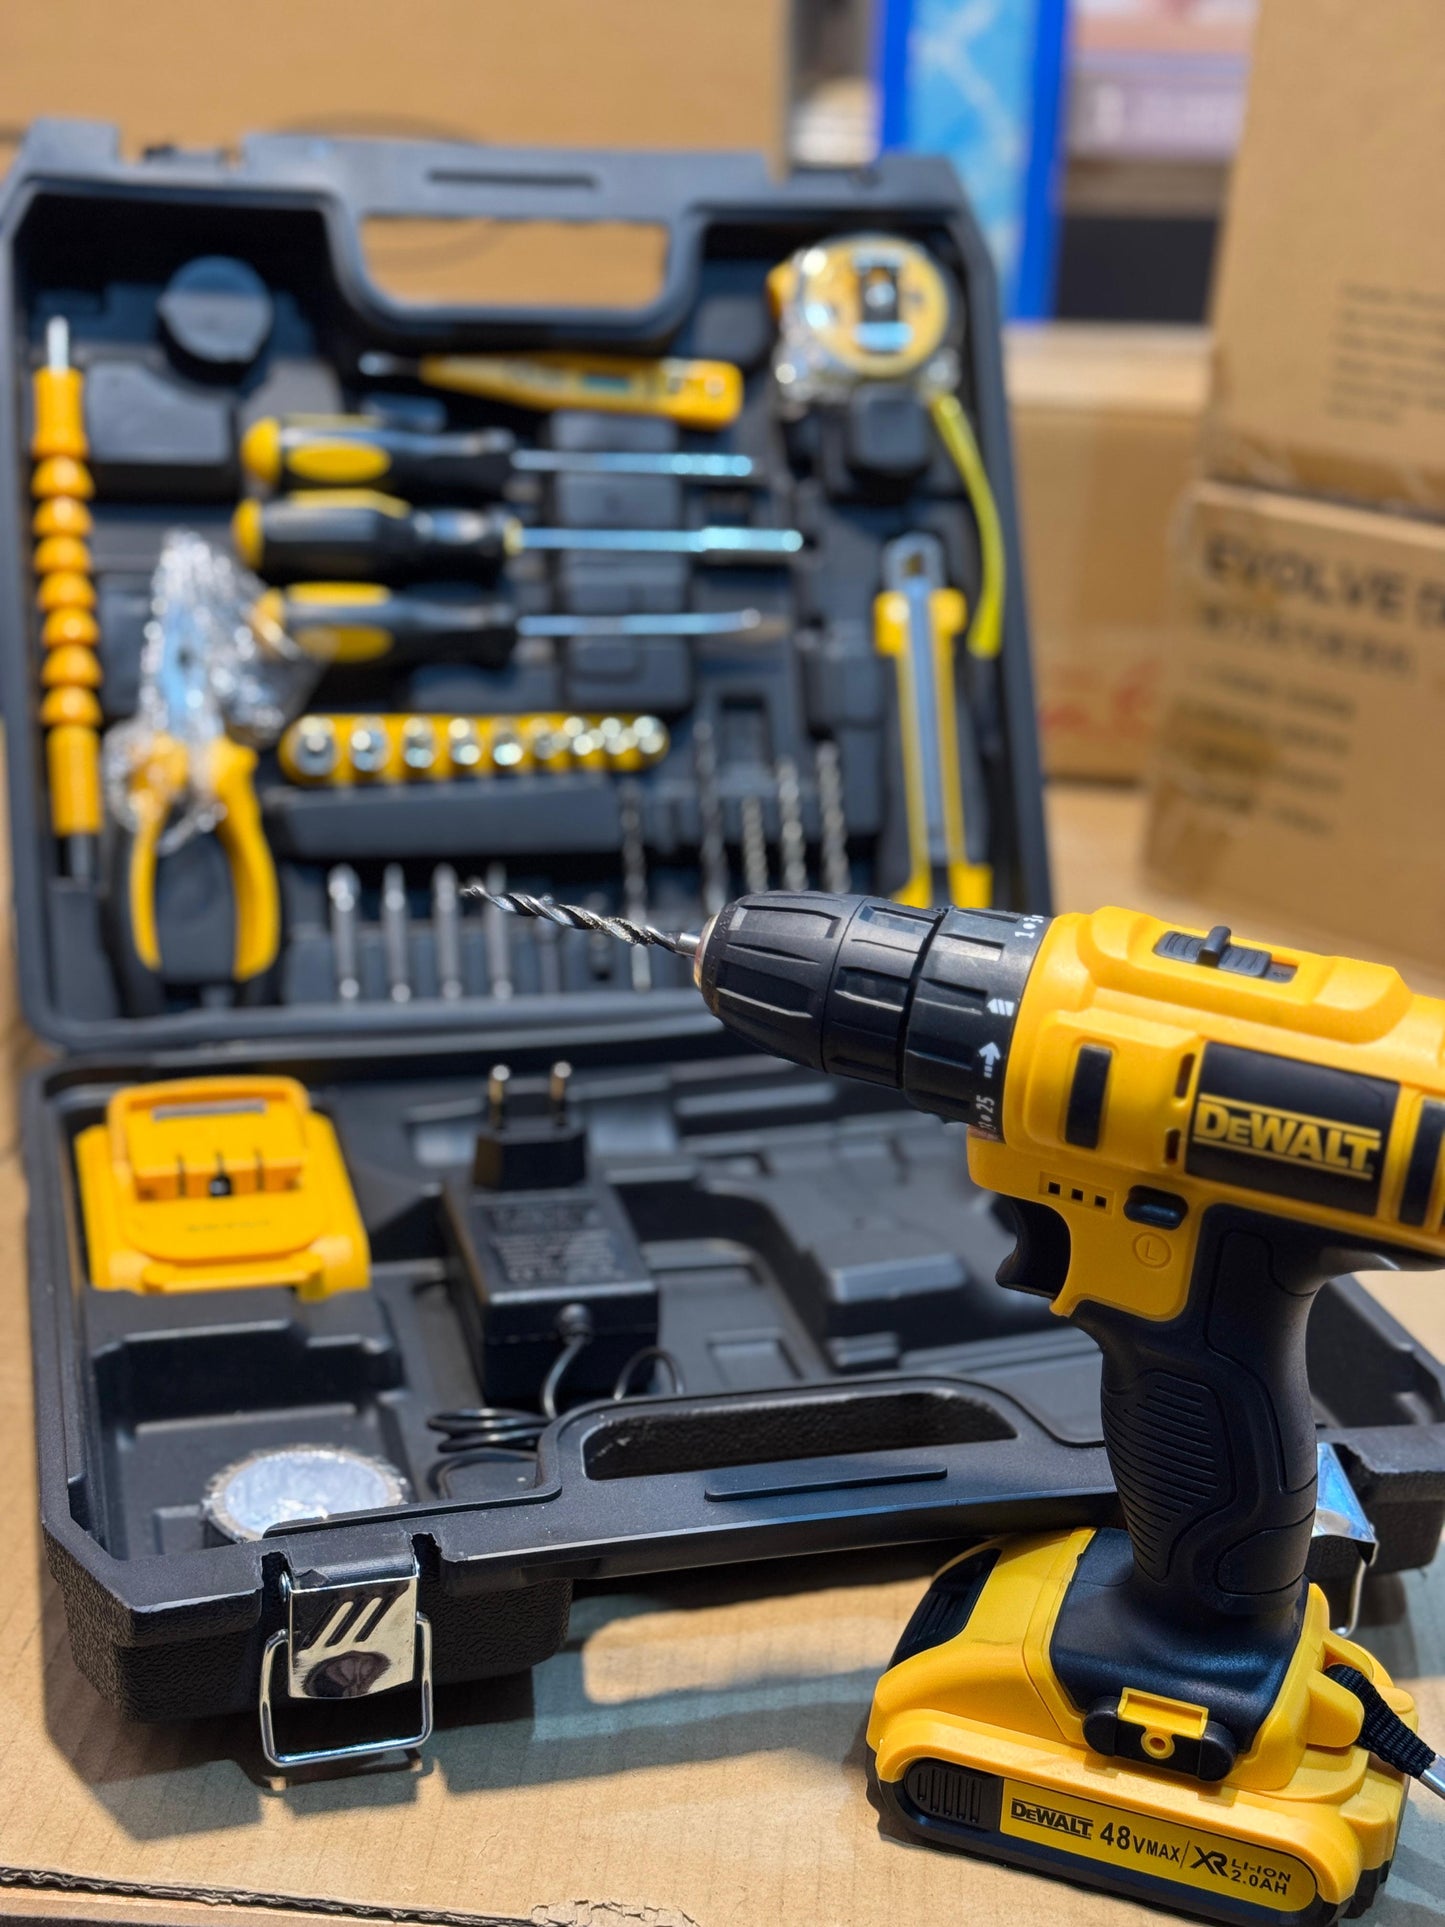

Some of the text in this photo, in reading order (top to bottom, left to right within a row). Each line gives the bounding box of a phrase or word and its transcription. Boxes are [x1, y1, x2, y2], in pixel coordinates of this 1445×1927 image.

[1193, 1101, 1381, 1172] DEWALT
[1011, 1800, 1094, 1837] DEWALT
[1231, 1858, 1291, 1883] LI-ION
[1231, 1869, 1287, 1895] 2.0AH
